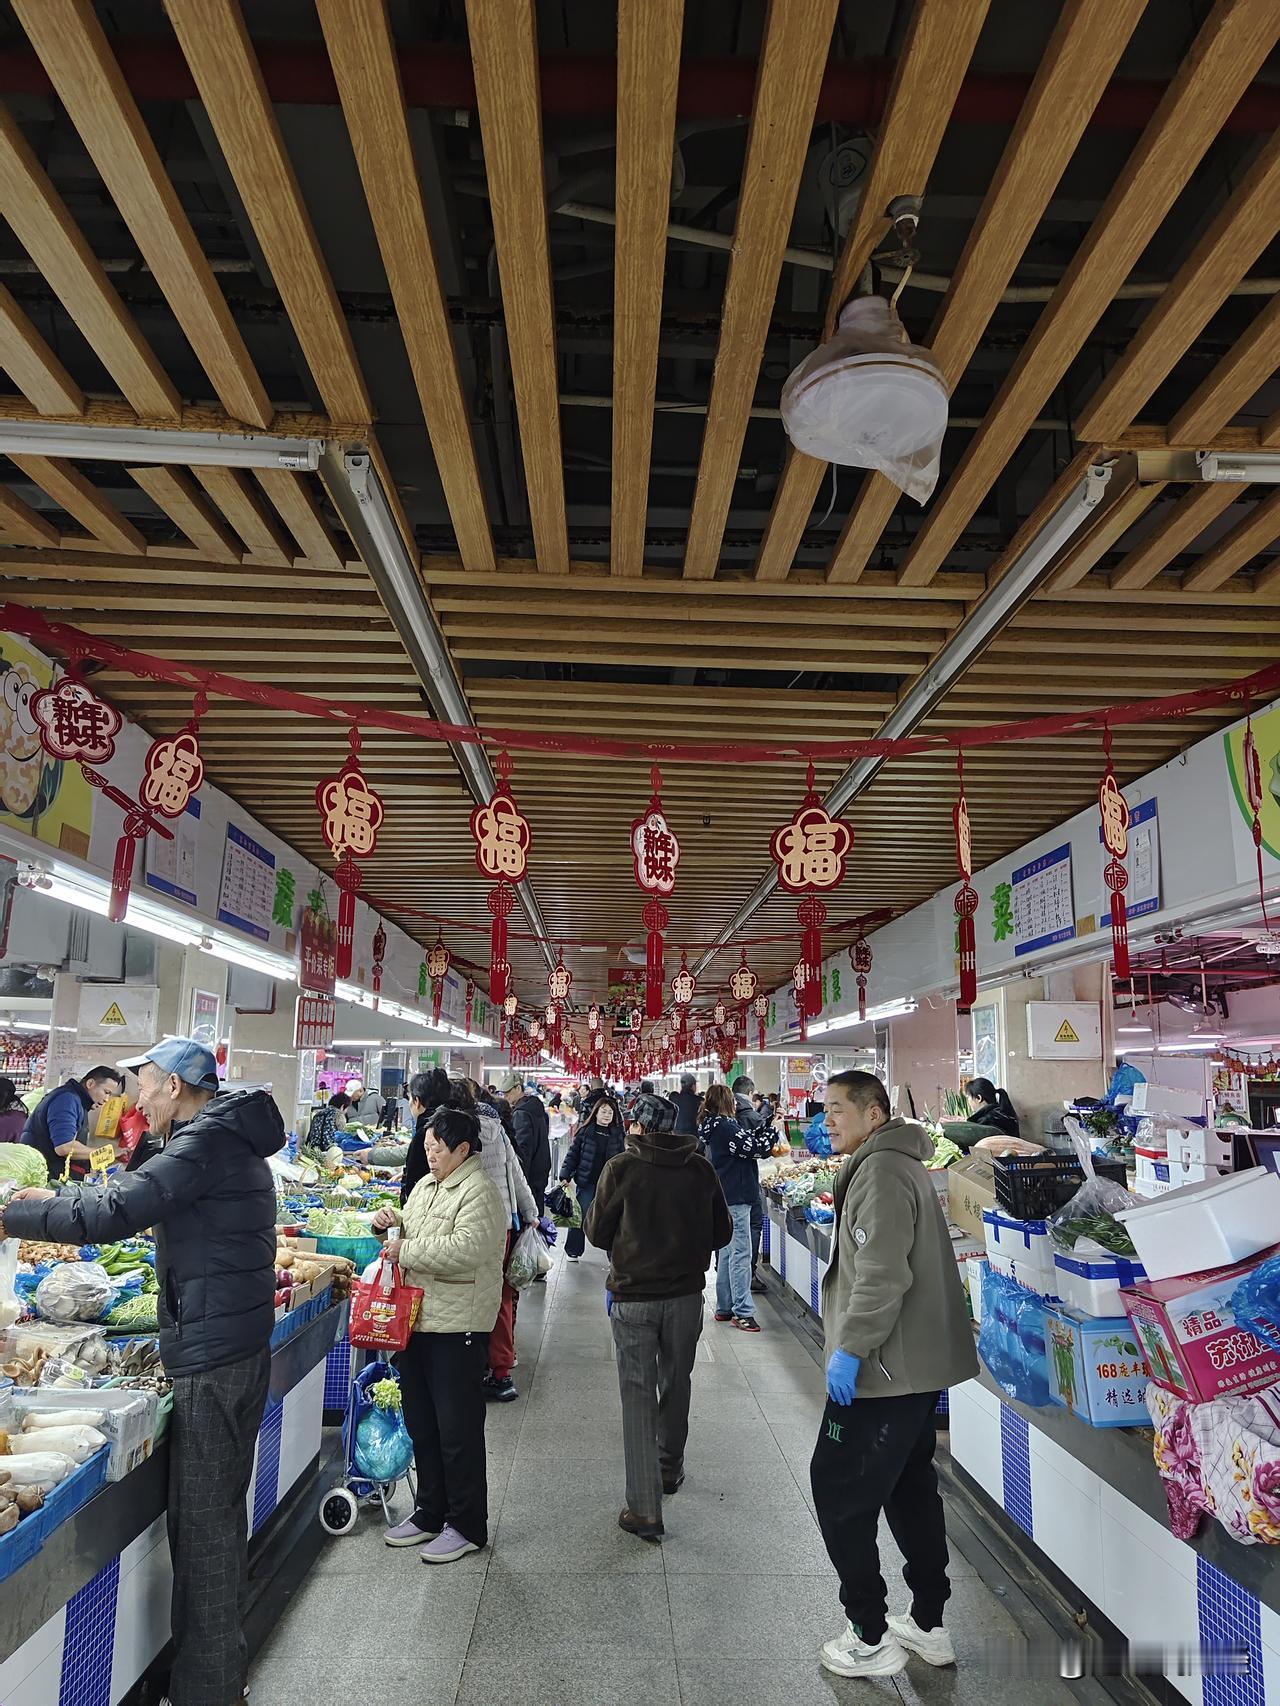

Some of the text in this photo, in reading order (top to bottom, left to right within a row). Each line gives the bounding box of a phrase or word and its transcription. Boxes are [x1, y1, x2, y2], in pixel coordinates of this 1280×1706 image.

[52, 697, 109, 725] 新年
[149, 743, 202, 809] 福
[328, 785, 375, 851] 福
[481, 809, 523, 874] 福
[784, 824, 840, 882] 福
[733, 971, 755, 999] 福
[1183, 1310, 1222, 1337] 精品
